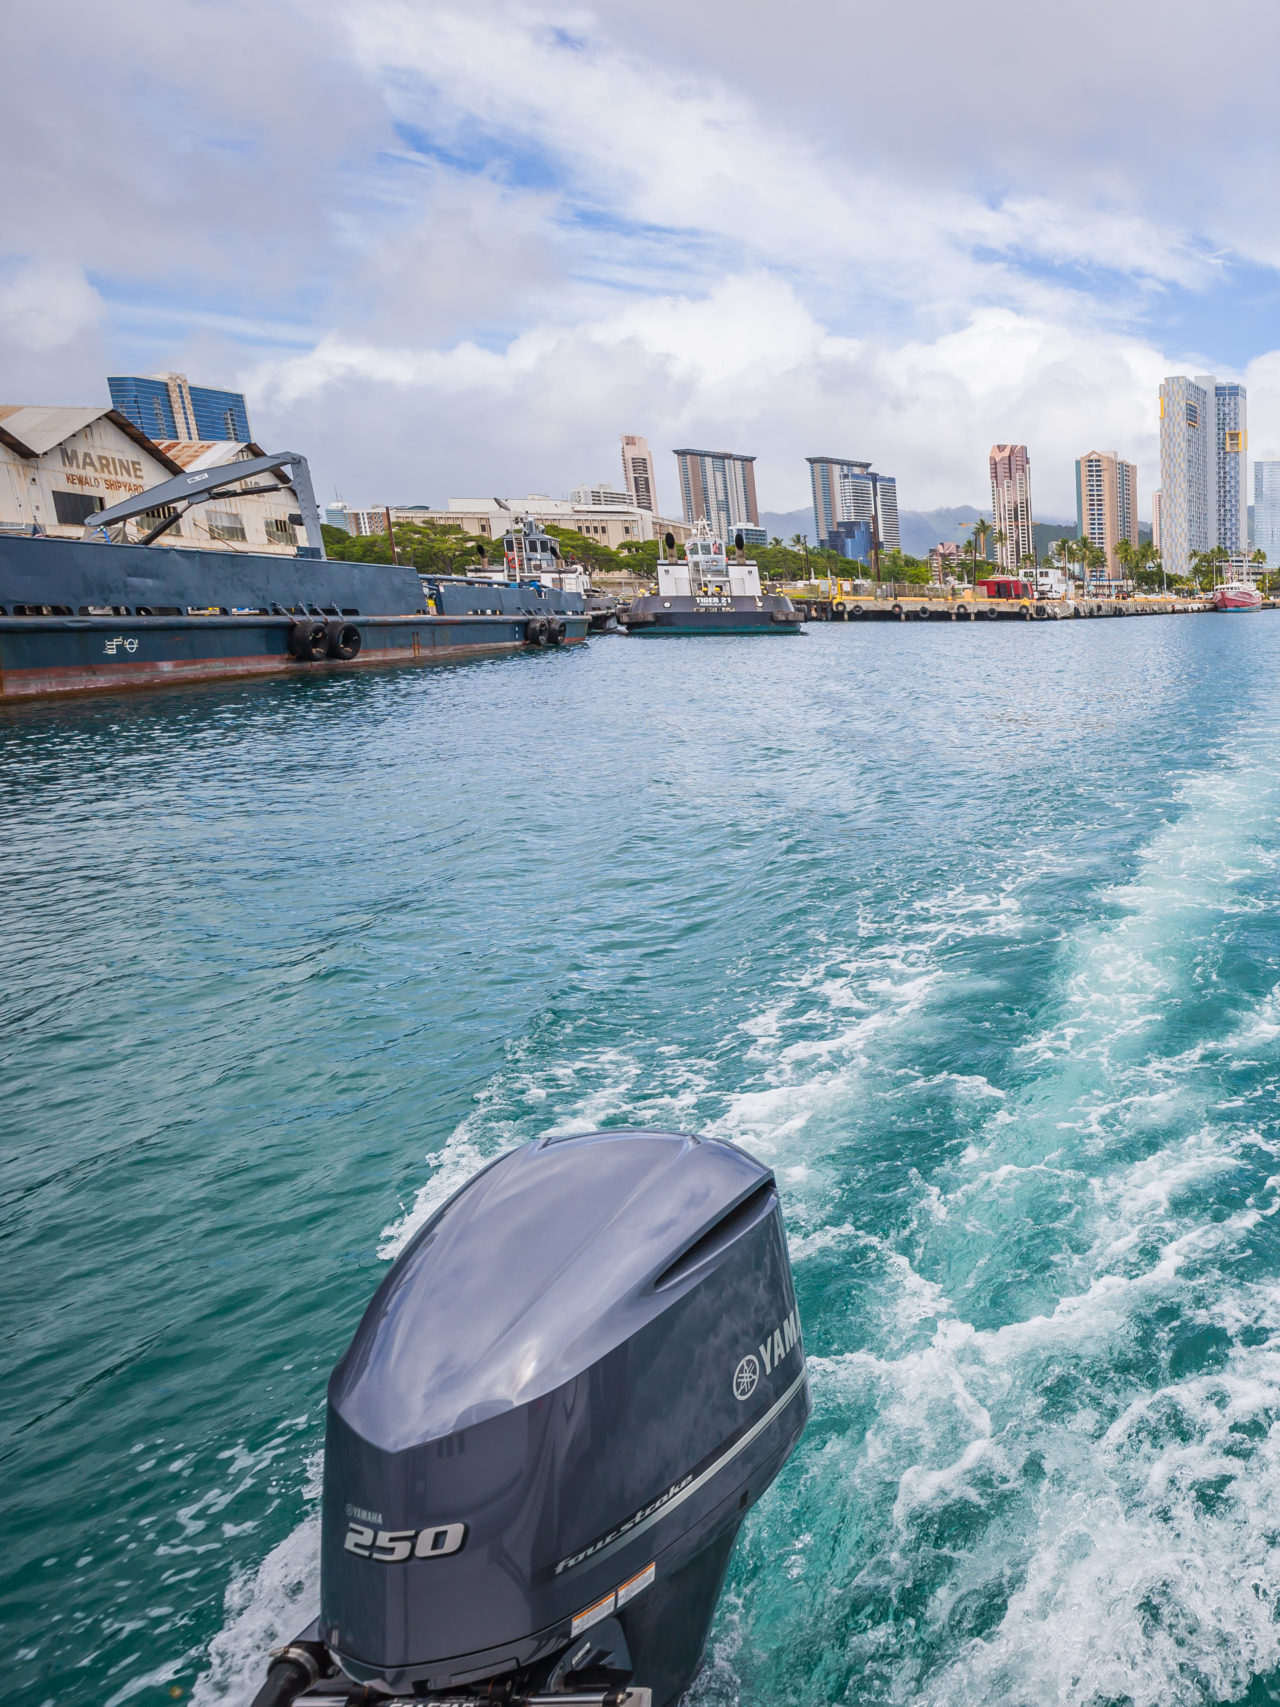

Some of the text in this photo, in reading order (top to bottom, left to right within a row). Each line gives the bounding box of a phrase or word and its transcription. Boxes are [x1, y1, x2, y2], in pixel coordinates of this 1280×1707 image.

[59, 447, 144, 479] MARINE
[66, 473, 144, 494] KEWALO SHIPYARD
[353, 1506, 383, 1525] YAMAHA
[344, 1522, 465, 1561] 250
